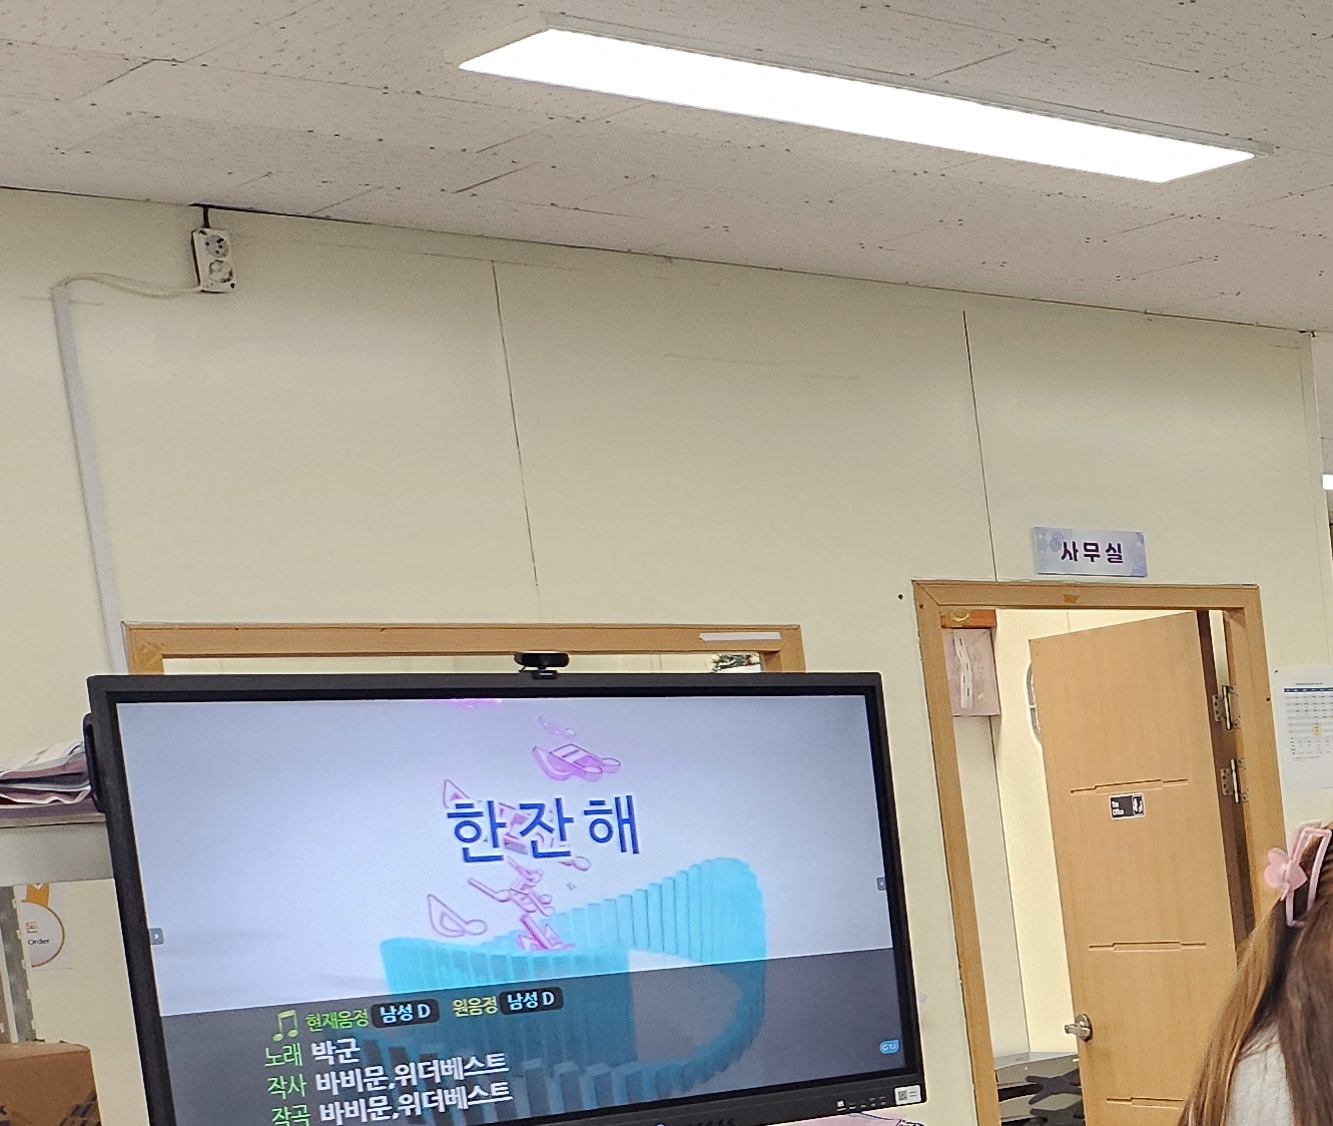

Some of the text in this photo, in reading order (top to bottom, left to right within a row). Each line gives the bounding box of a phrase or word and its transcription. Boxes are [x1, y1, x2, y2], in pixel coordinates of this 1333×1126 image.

[1060, 540, 1124, 564] 사무실
[446, 794, 640, 864] 한잔해
[27, 938, 50, 946] Order
[305, 991, 555, 1033] 현재음정 남성 D 원음정 남성 D
[264, 1037, 361, 1068] 노래 박군
[267, 1052, 510, 1099] 작사 바비문,위더베스트
[319, 1081, 514, 1126] 바비문,위더베스트
